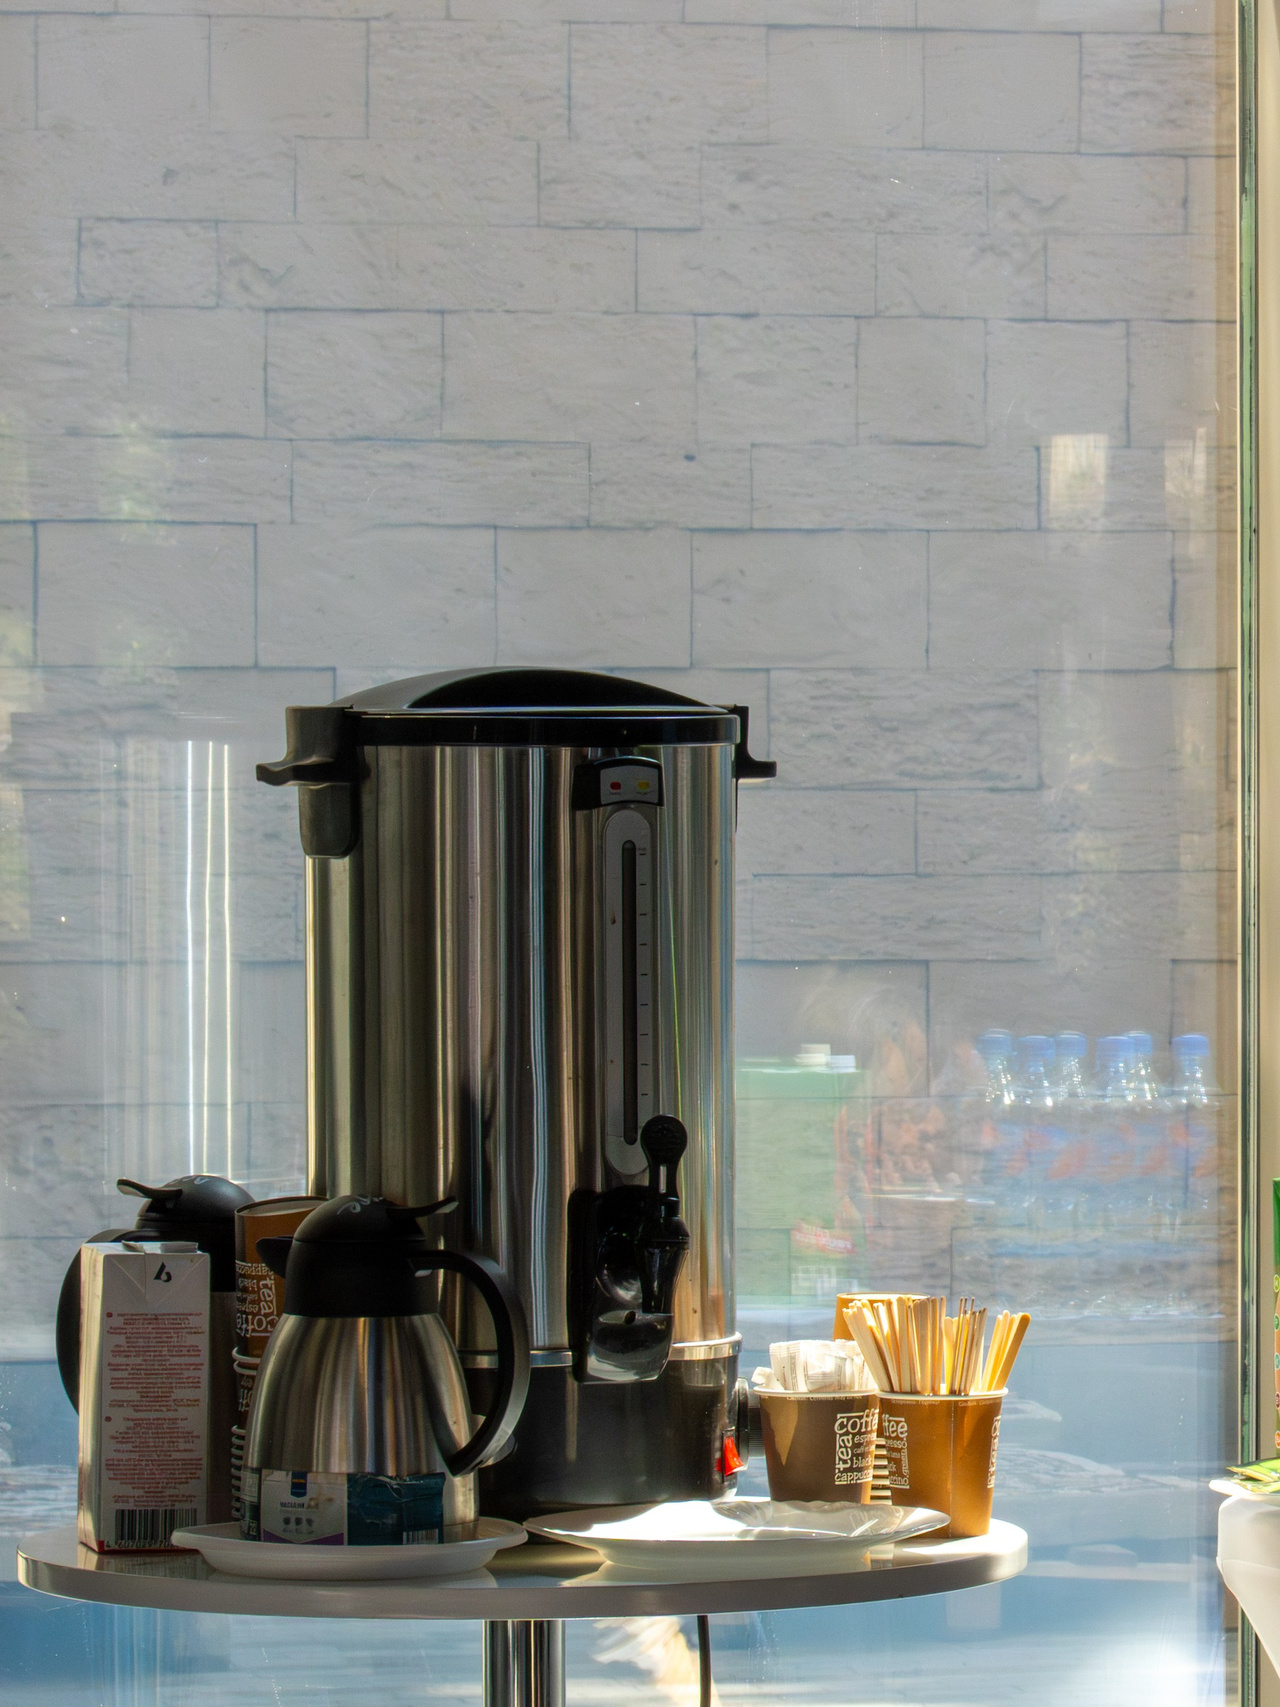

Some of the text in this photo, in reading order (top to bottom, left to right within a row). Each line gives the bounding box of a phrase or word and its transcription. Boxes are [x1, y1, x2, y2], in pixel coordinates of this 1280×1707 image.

[260, 1277, 274, 1315] tea
[834, 1408, 879, 1434] coffe
[881, 1413, 908, 1438] ffee
[836, 1434, 852, 1473] tea
